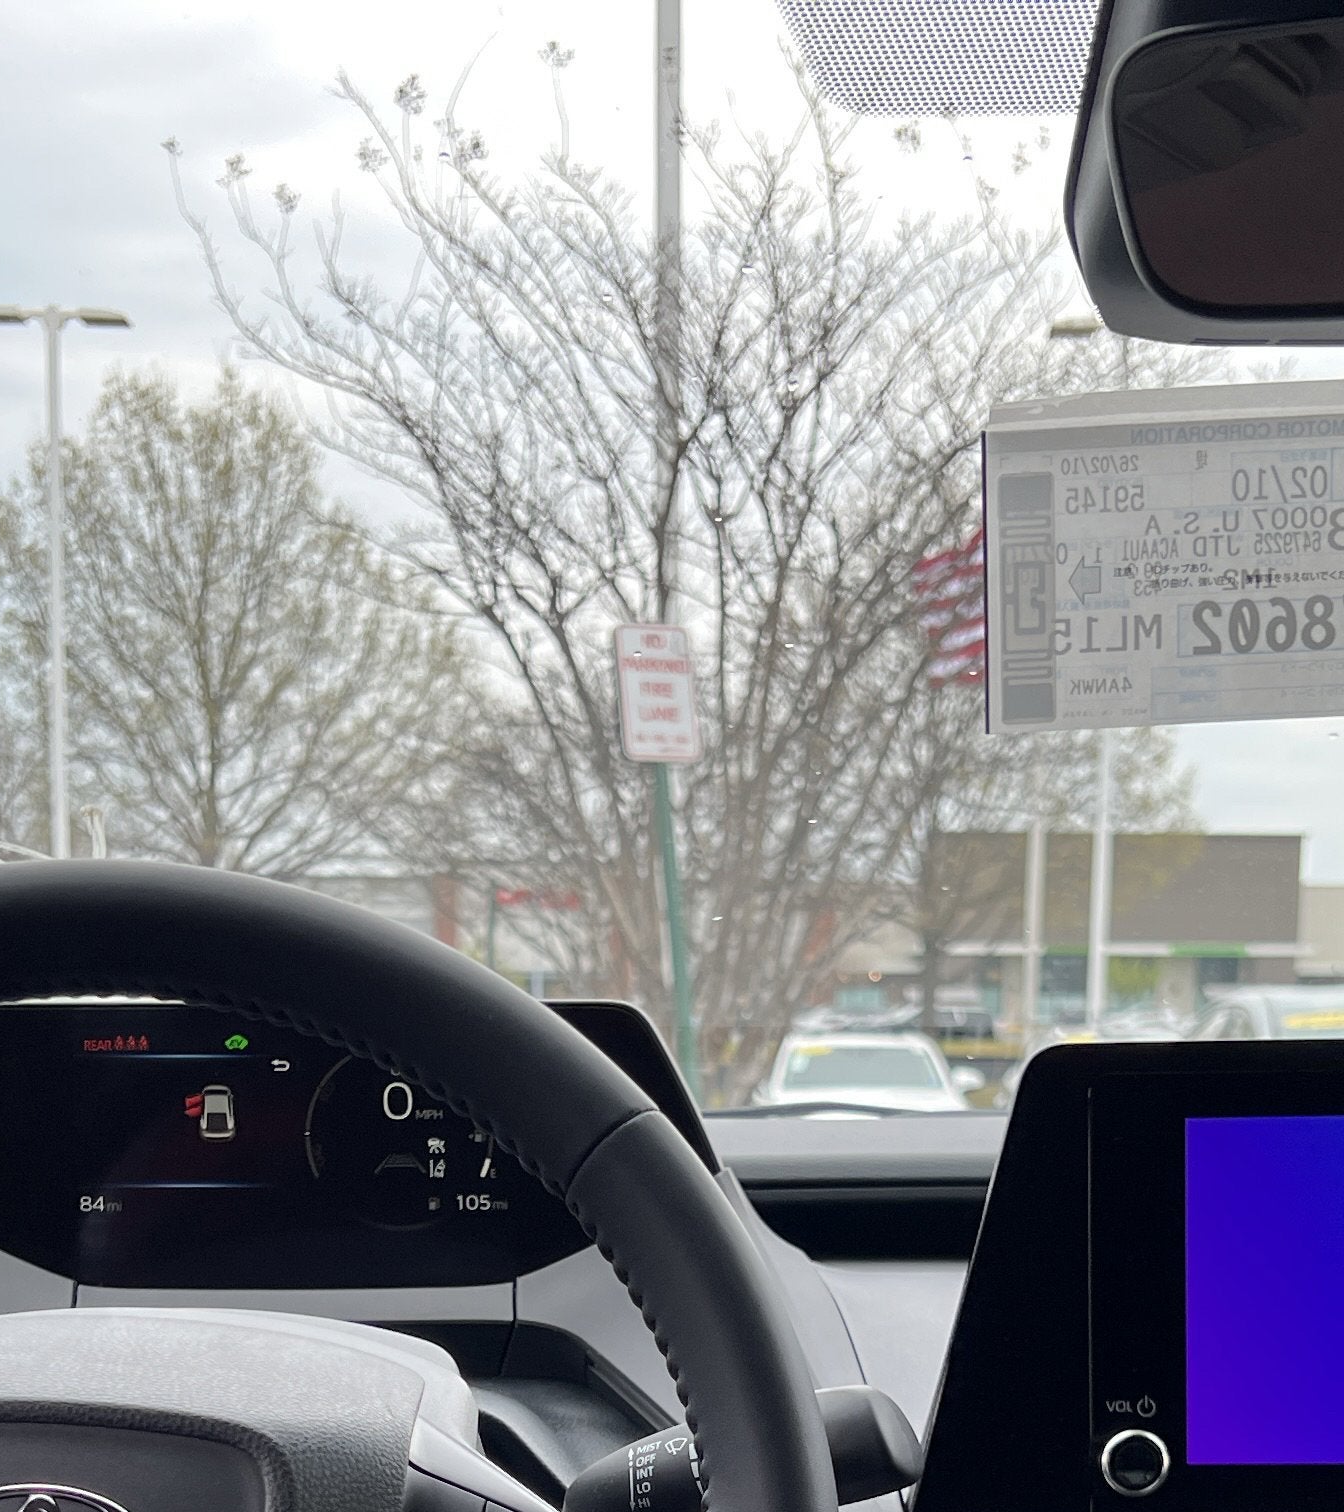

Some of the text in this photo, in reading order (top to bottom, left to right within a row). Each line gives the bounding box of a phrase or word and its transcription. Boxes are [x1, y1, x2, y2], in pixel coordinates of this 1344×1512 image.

[383, 1081, 444, 1121] 0 MPH
[1106, 1400, 1133, 1413] VOL
[636, 1441, 662, 1455] MIST
[636, 1453, 656, 1467] OFF
[636, 1466, 654, 1480] INT
[636, 1482, 651, 1494] LO
[637, 1497, 651, 1509] HI
